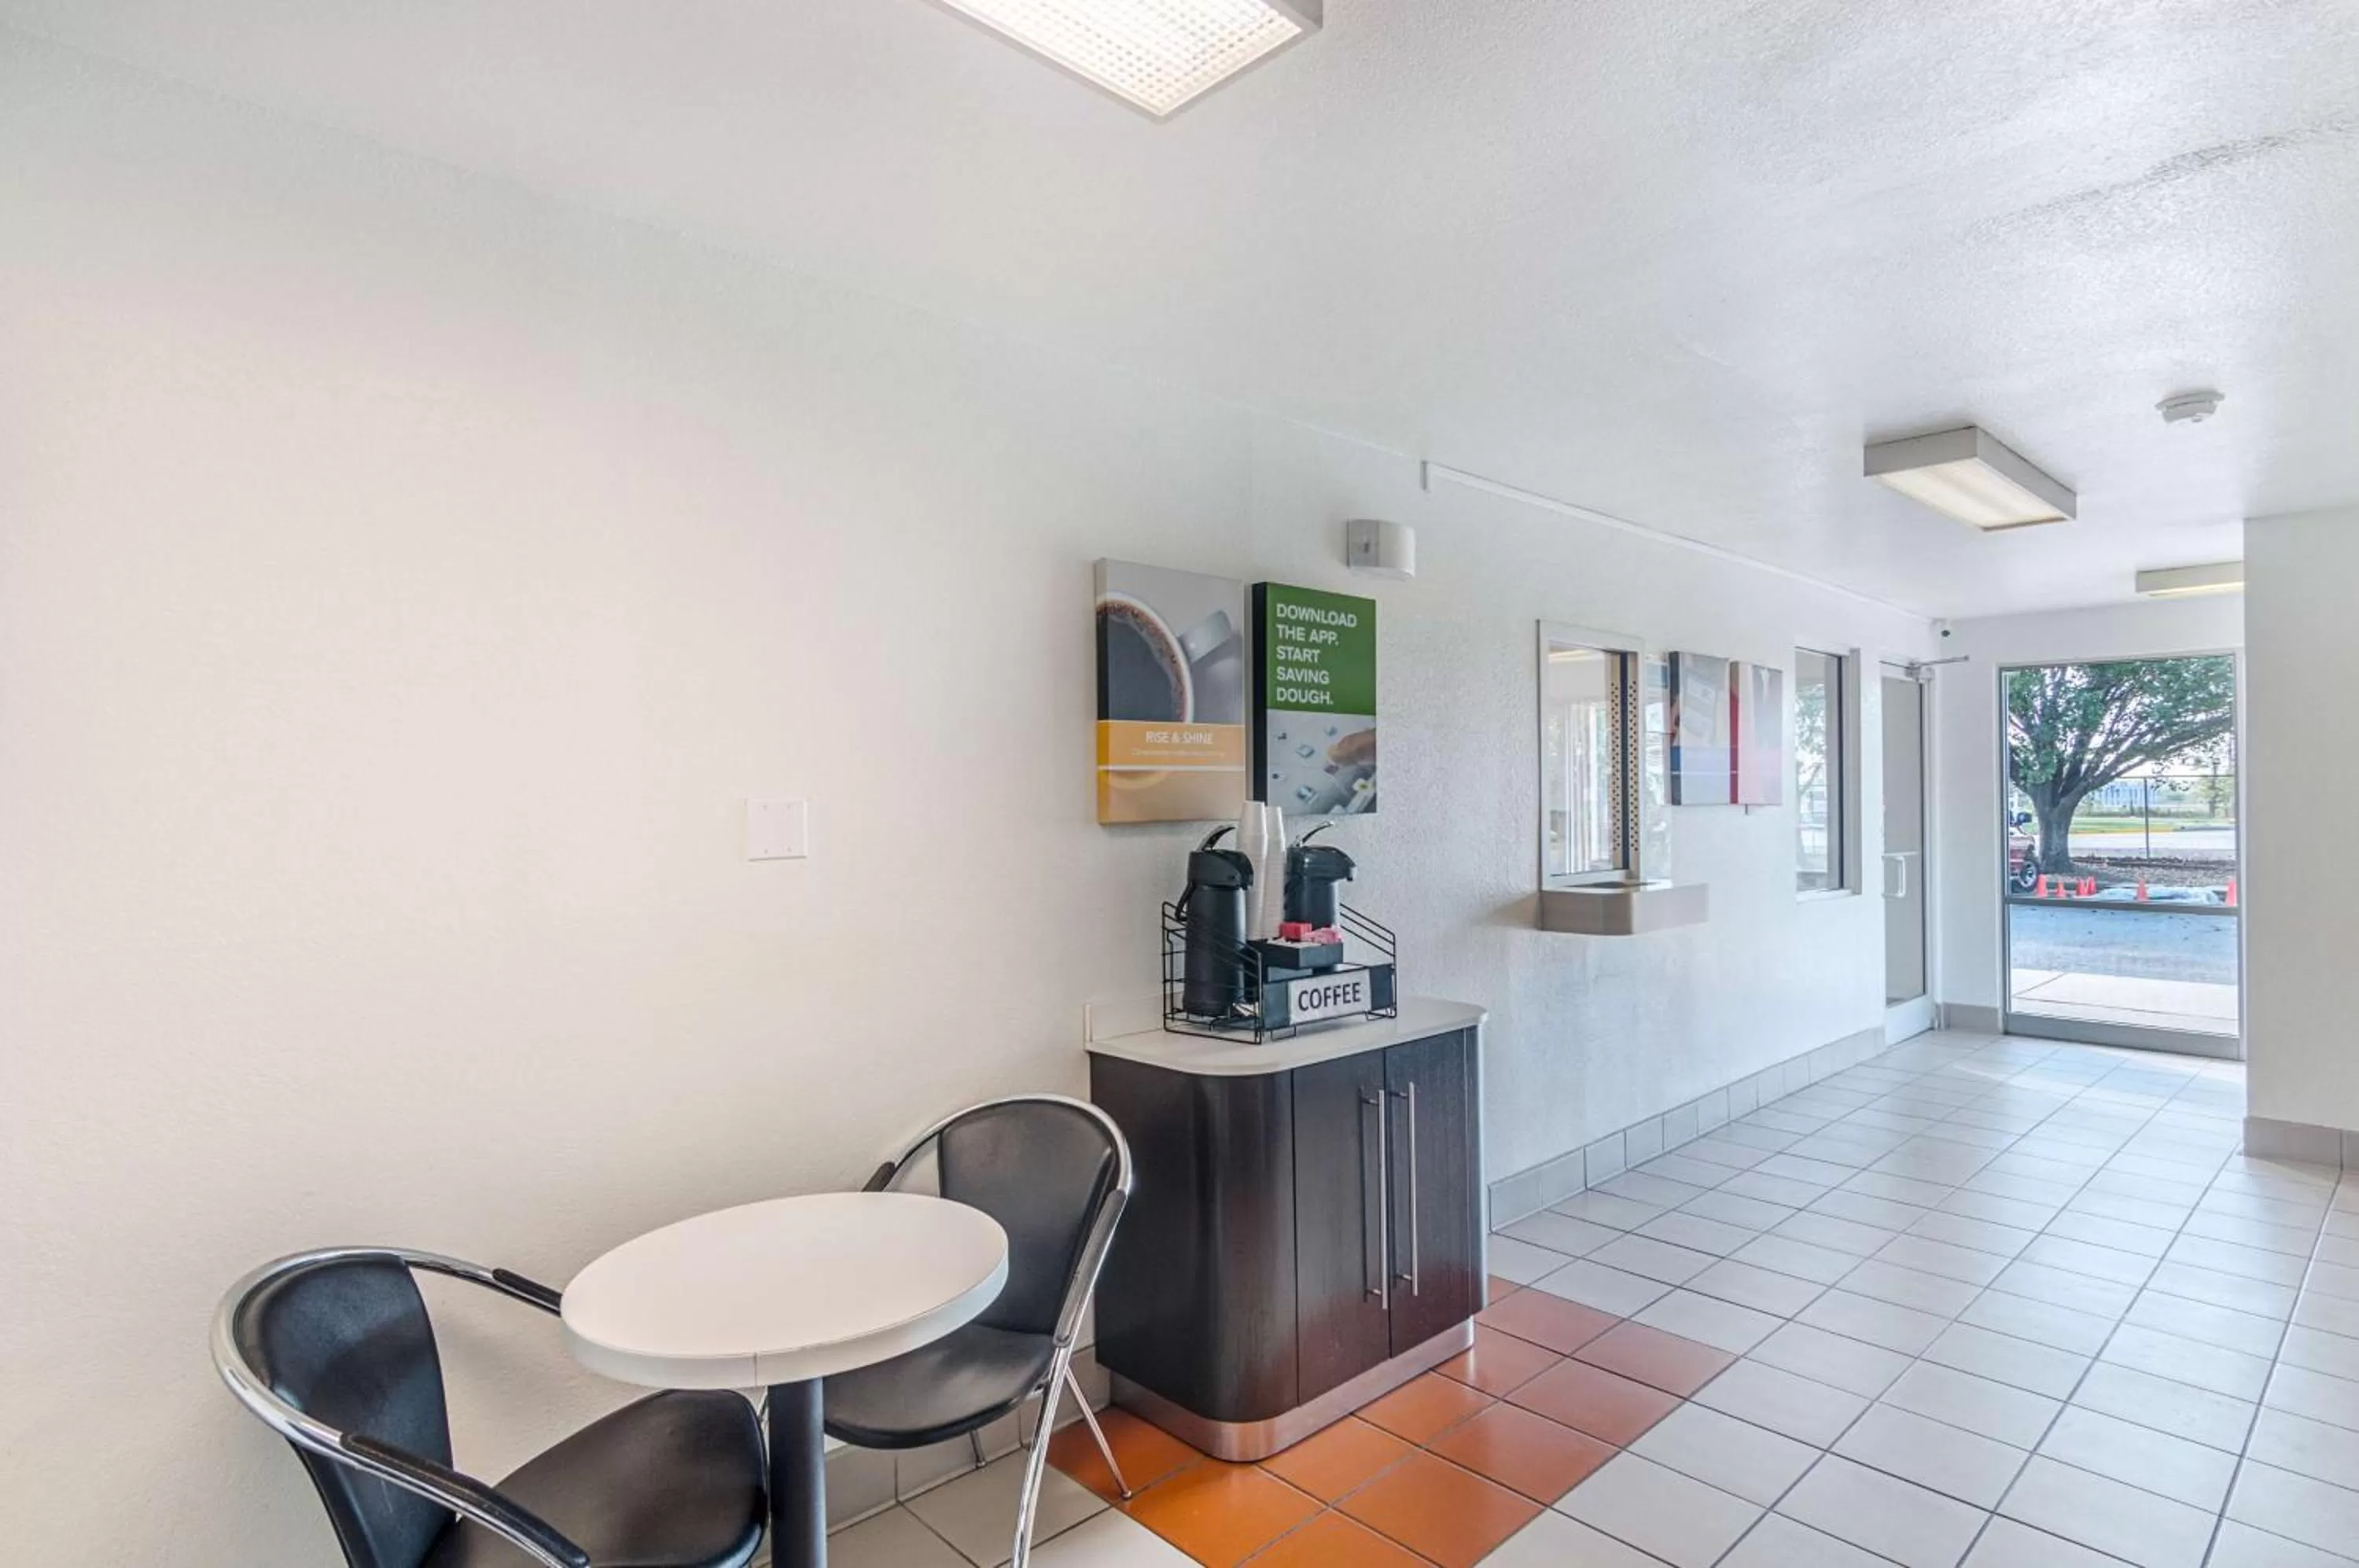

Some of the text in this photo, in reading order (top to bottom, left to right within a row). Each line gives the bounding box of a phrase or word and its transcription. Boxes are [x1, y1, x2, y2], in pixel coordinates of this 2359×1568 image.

[1276, 603, 1357, 628] DOWNLOAD
[1275, 624, 1339, 646] THE APP.
[1276, 645, 1320, 663] START
[1276, 666, 1330, 685] SAVING
[1276, 686, 1334, 705] DOUGH.
[1146, 731, 1169, 743] RISE
[1182, 731, 1213, 744] SHINE
[1299, 982, 1361, 1010] COFFEE
